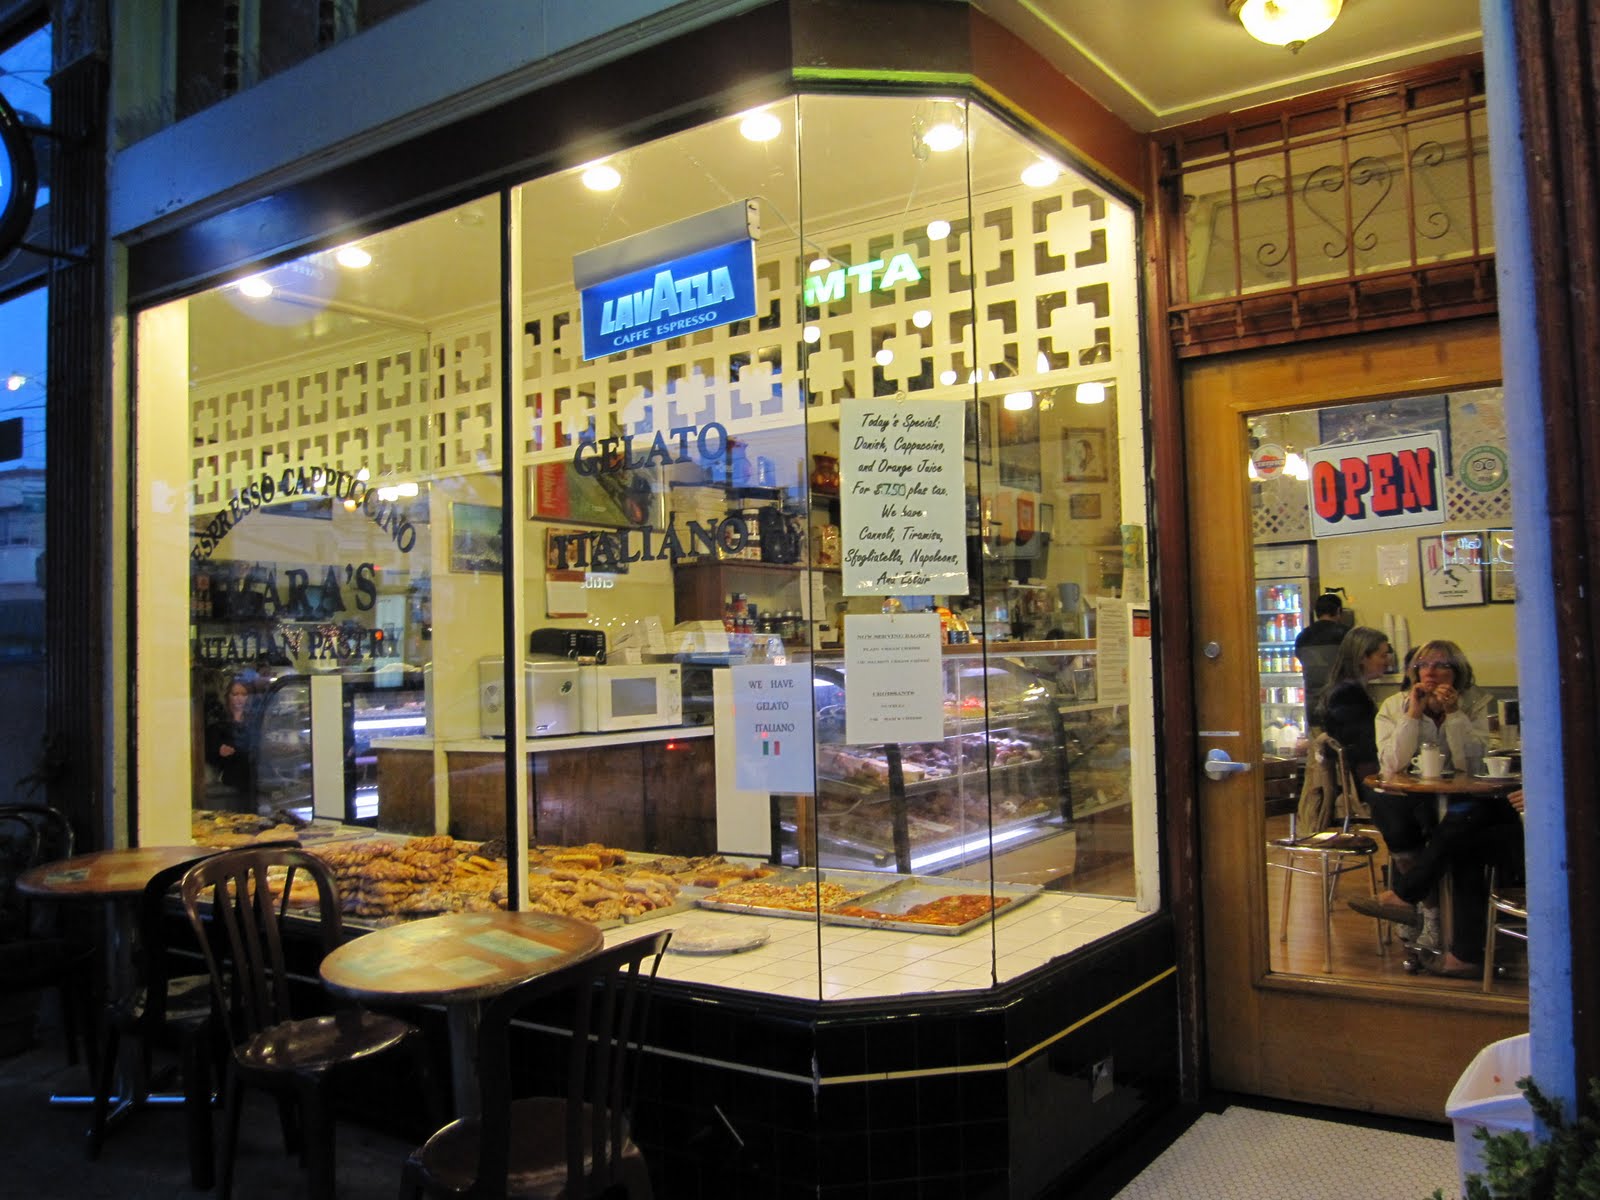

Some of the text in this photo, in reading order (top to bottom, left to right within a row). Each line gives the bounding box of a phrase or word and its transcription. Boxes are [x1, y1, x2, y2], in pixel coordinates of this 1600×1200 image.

[600, 265, 735, 336] LAVAZZA
[656, 311, 718, 335] ESPRESSO
[861, 413, 941, 432] Today's Special:
[573, 421, 728, 477] GELATO
[853, 436, 945, 455] Danish, Cappuccino,
[858, 459, 943, 477] and Orange Juice
[852, 480, 871, 495] For
[905, 482, 928, 500] plus
[931, 484, 949, 496] tax.
[1312, 447, 1438, 523] OPEN
[190, 465, 417, 561] ESPRESSO CAPPUCCINO
[881, 503, 897, 518] We
[553, 515, 748, 571] ITALIANO
[859, 526, 944, 543] Cannoli, Tiramisu,
[909, 548, 960, 567] Napoleons,
[308, 627, 403, 660] PASTRY
[748, 679, 794, 689] WE HAVE
[756, 701, 789, 711] GELATO
[755, 723, 795, 733] ITALIANO
